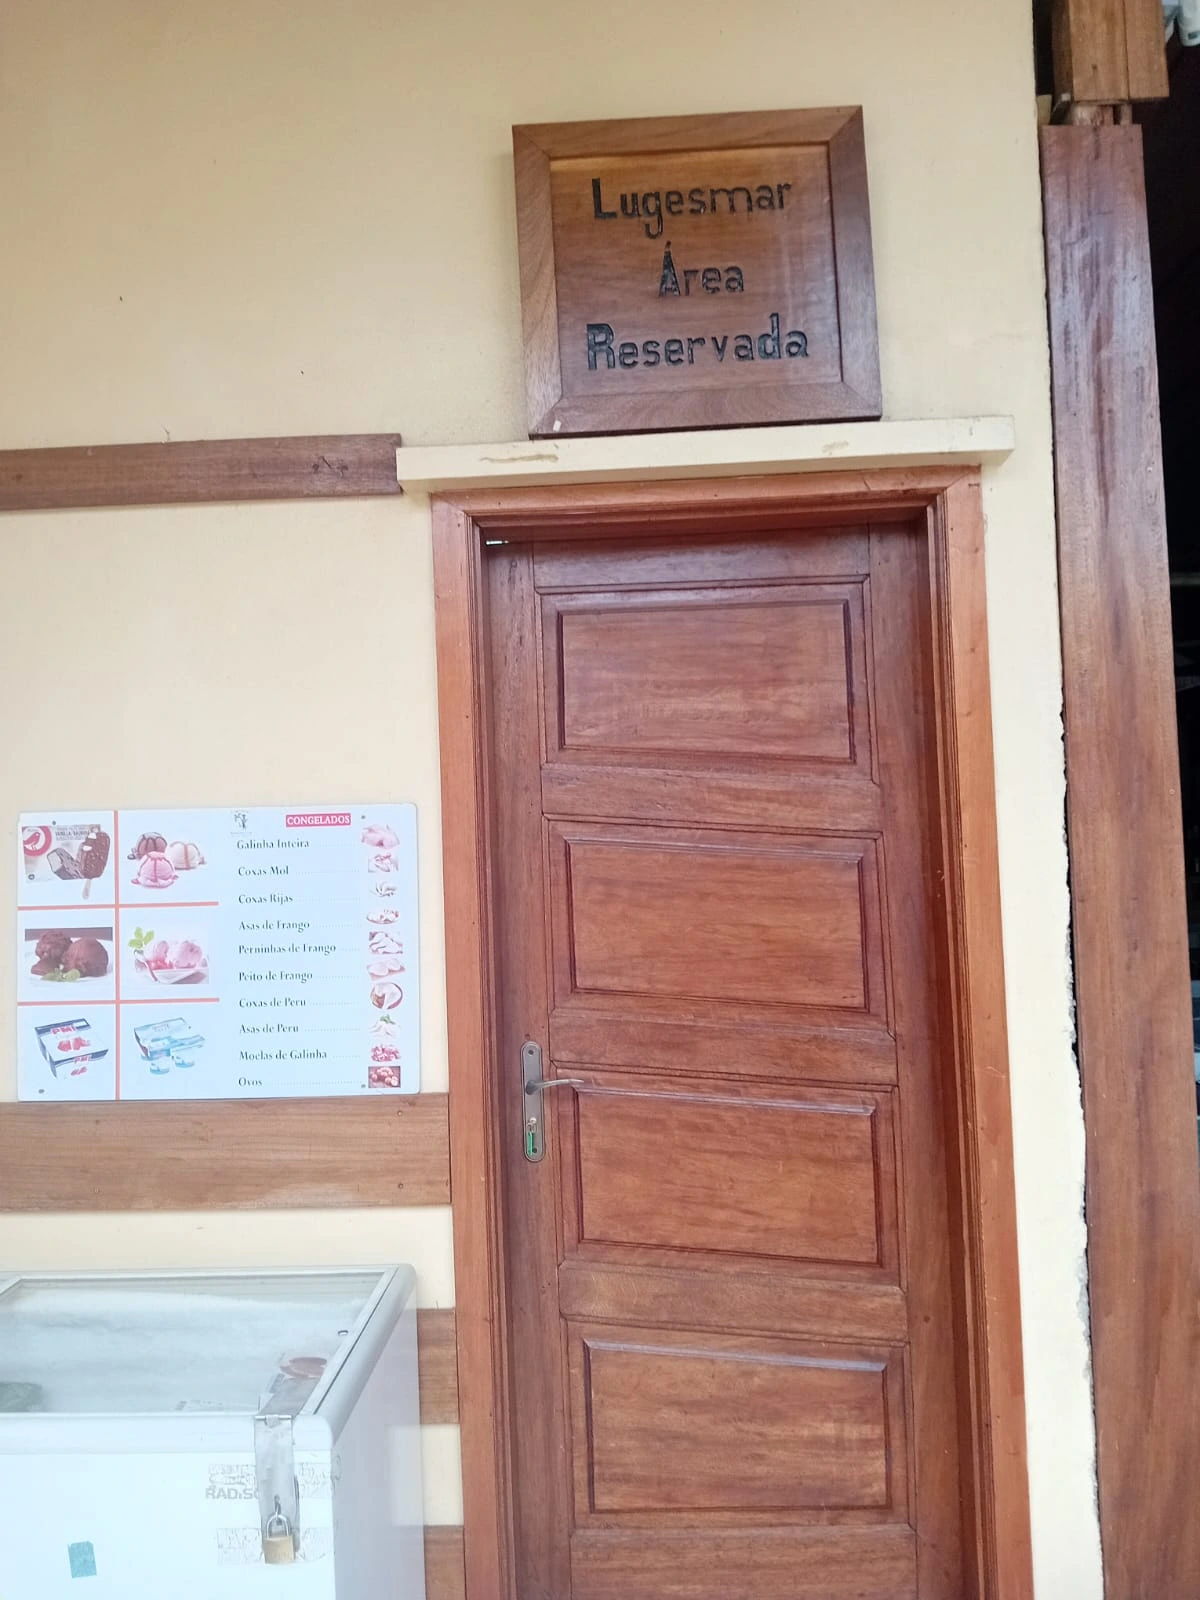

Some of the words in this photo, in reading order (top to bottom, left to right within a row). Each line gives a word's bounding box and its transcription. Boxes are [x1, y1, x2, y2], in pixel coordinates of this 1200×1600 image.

[591, 177, 793, 240] Lugesmar
[658, 240, 745, 298] Área
[586, 312, 810, 371] Reservada
[287, 814, 350, 826] CONGELADOS
[236, 839, 274, 850] Galinha
[277, 838, 310, 849] Inteira
[238, 866, 267, 877] Coxas
[270, 865, 289, 876] Mol
[238, 894, 268, 905] Coxas
[270, 893, 294, 906] Rijas
[238, 920, 261, 931] Asas
[262, 920, 274, 930] de
[277, 919, 310, 933] Frango
[238, 944, 286, 955] Perninhas
[288, 944, 301, 954] de
[303, 943, 337, 956] Frango
[238, 971, 263, 982] Peito
[265, 971, 277, 981] de
[280, 970, 313, 984] Frango
[239, 998, 268, 1008] Coxas
[270, 998, 282, 1008] de
[284, 997, 307, 1007] Peru
[239, 1023, 261, 1034] Asas
[262, 1023, 275, 1033] de
[277, 1023, 300, 1033] Peru
[239, 1050, 273, 1061] Moelas
[275, 1050, 289, 1060] de
[290, 1049, 328, 1060] Galinha
[238, 1077, 263, 1087] Ovos
